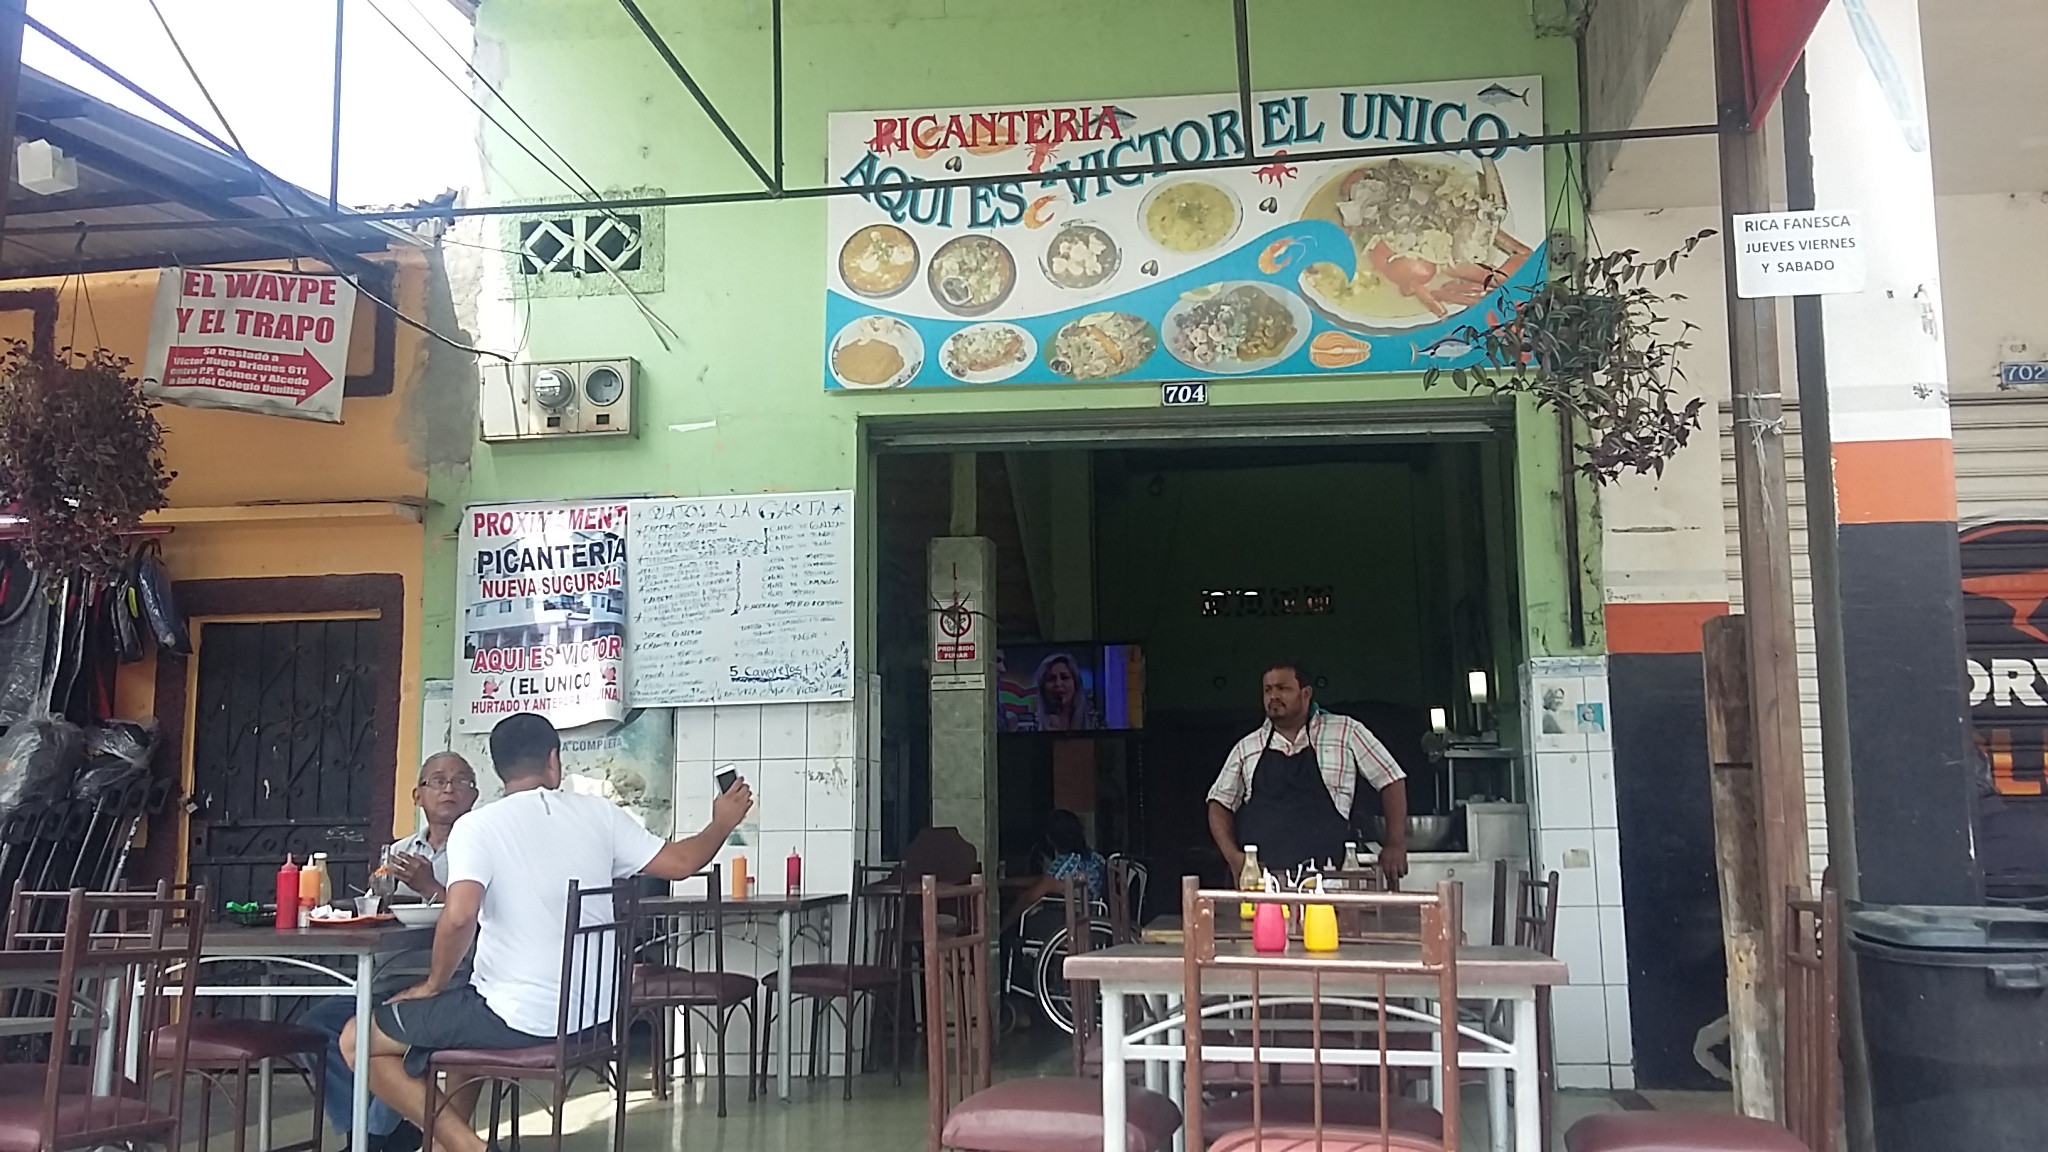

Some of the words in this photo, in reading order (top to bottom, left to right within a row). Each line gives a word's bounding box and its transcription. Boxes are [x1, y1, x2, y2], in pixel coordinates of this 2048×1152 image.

[873, 105, 1122, 152] PICANTERIA
[841, 150, 954, 229] AQUI
[966, 181, 1028, 229] ES
[1040, 109, 1246, 204] VICTOR
[1259, 95, 1325, 148] EL
[1340, 91, 1509, 162] UNICO
[1744, 219, 1779, 232] RICA
[1784, 215, 1851, 230] FANESCA
[1745, 240, 1795, 253] JUEVES
[1798, 237, 1856, 251] VIERNES
[1761, 262, 1770, 274] Y
[1777, 260, 1835, 273] SABADO
[183, 271, 216, 298] EL
[224, 272, 336, 305] WAYPE
[176, 308, 195, 333] Y
[199, 309, 225, 334] EL
[235, 309, 335, 343] TRAPO
[203, 347, 216, 356] Se
[206, 357, 236, 368] Hugo
[238, 361, 286, 374] Briones
[2004, 366, 2047, 380] 702
[170, 367, 198, 375] entre
[259, 374, 267, 382] y
[268, 374, 309, 386] Alcedo
[198, 376, 216, 386] del
[217, 378, 260, 391] Colegio
[1166, 384, 1205, 403] 704
[477, 538, 627, 575] PICANTERIA
[482, 578, 537, 598] NUEVA
[542, 568, 621, 595] SUCURSAL
[473, 648, 524, 673] AQUI
[531, 647, 554, 669] ES
[561, 636, 621, 667] VICTOR
[545, 672, 591, 692] UNICO
[471, 699, 520, 714] HURTADO
[523, 698, 531, 712] Y
[572, 737, 623, 752] COMPLETA
